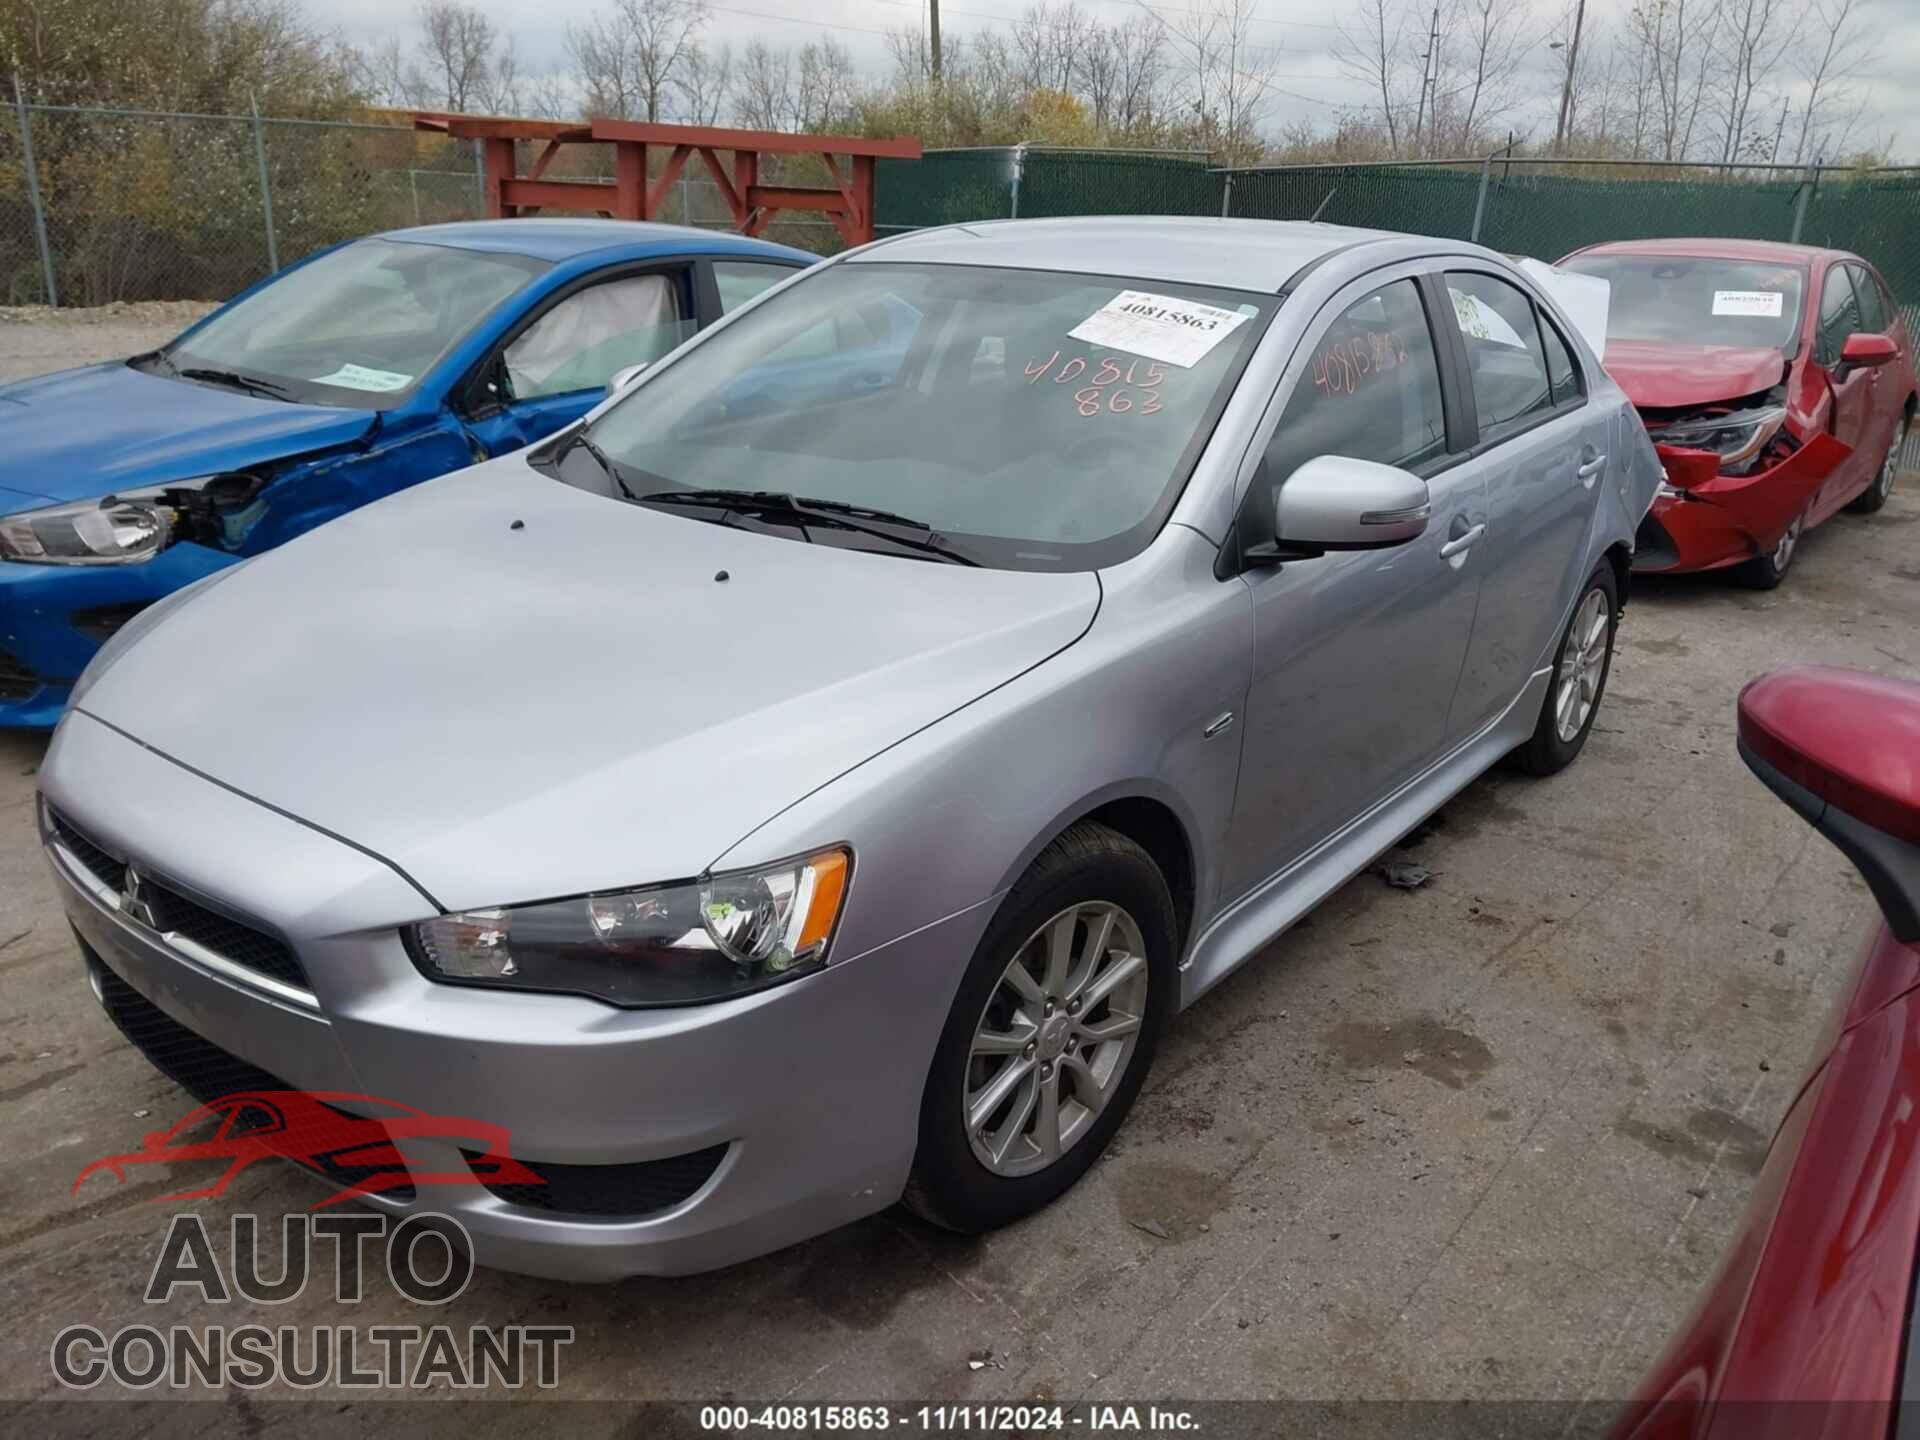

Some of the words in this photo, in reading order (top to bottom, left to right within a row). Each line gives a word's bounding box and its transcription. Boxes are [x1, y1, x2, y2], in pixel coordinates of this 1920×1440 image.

[1120, 302, 1218, 330] 40815863
[1024, 351, 1167, 388] 40815
[1074, 387, 1163, 416] 863
